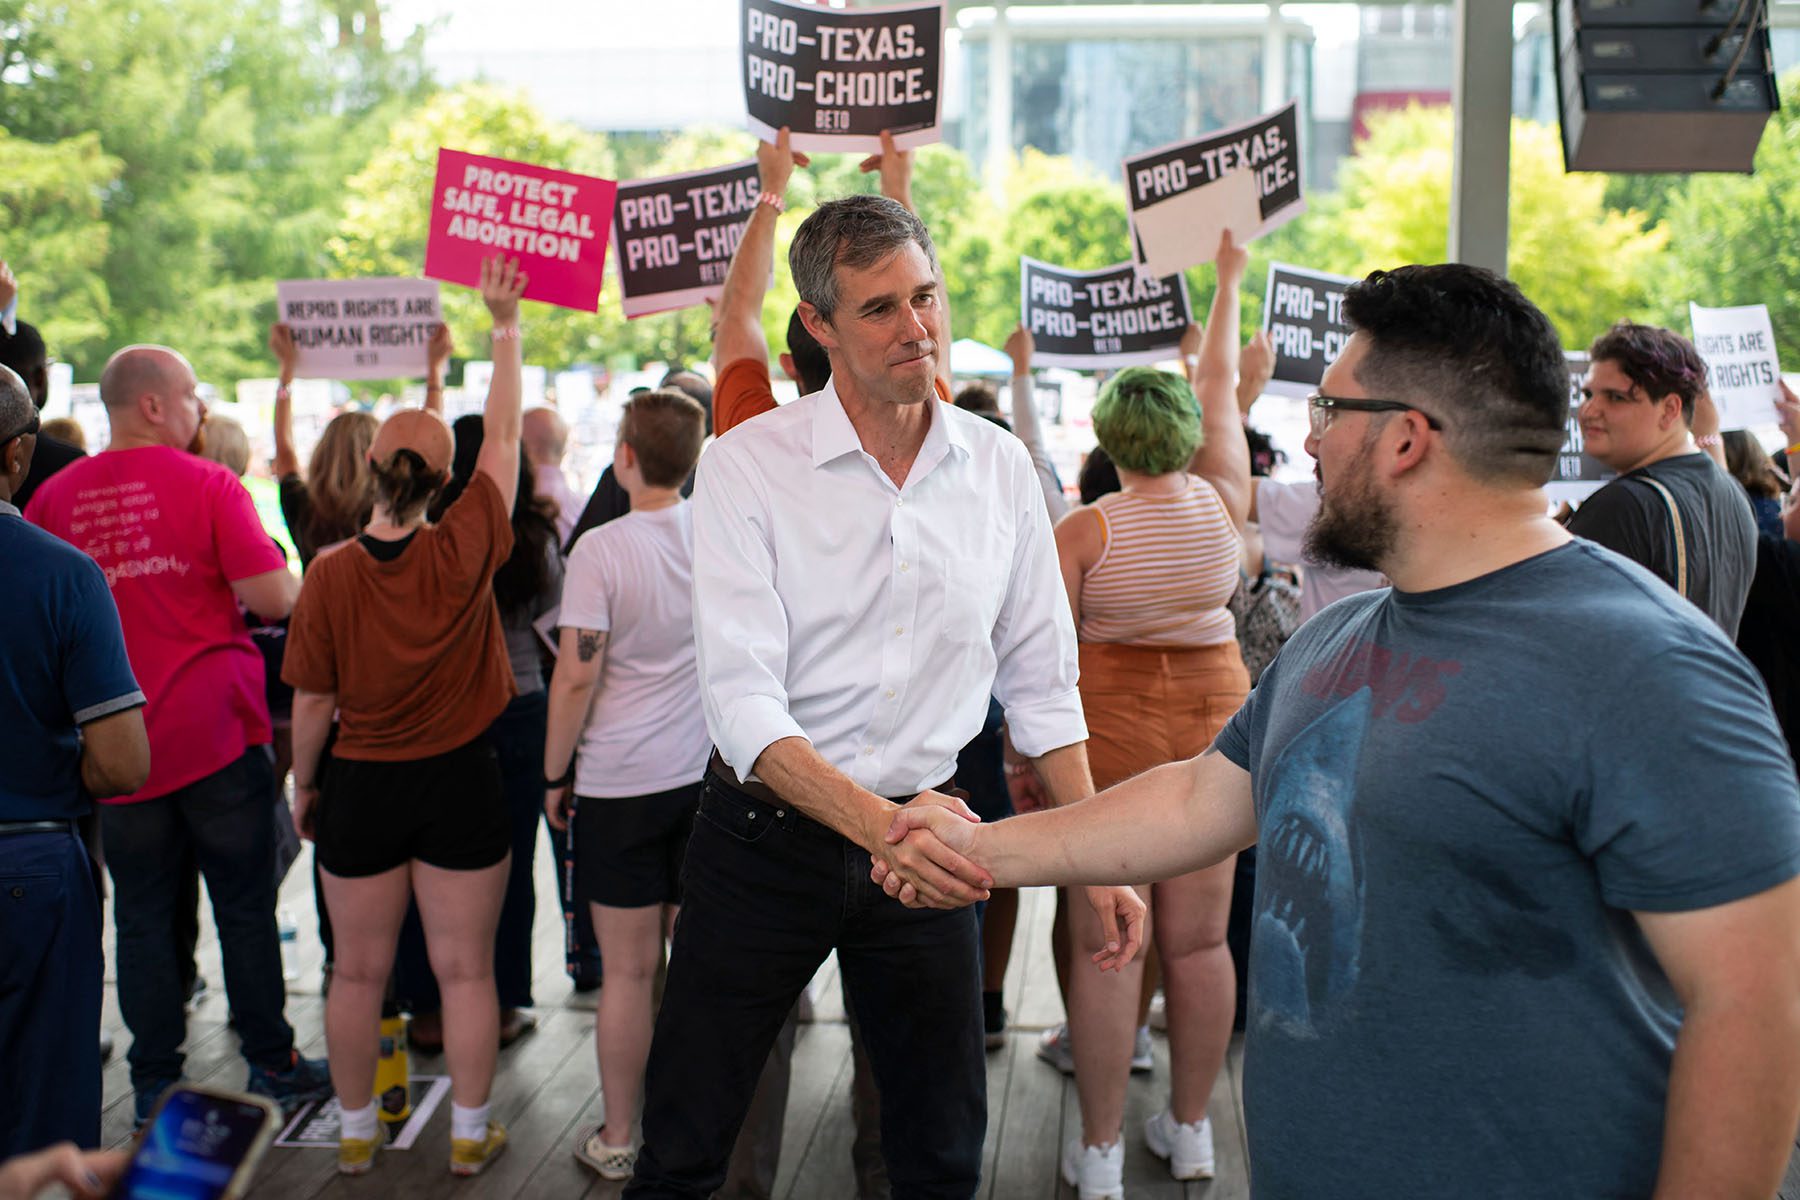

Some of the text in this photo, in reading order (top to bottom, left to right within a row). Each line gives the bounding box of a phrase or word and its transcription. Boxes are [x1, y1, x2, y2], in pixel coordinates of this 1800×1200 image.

[748, 8, 925, 62] PRO-TEXAS.
[748, 54, 933, 107] PRO-CHOICE.
[815, 110, 850, 129] BETO
[1136, 126, 1288, 200] PRO-TEXAS.
[463, 164, 579, 208] PROTECT
[443, 187, 594, 240] SAFE, LEGAL
[447, 214, 582, 263] ABORTION
[626, 222, 747, 271] PRO-CHO
[287, 298, 434, 320] REPRO RIGHTS ARE
[1031, 301, 1185, 338] PRO-CHOICE.
[291, 324, 363, 349] HUMAN
[1739, 330, 1767, 352] ARE
[1716, 361, 1773, 388] RIGHTS
